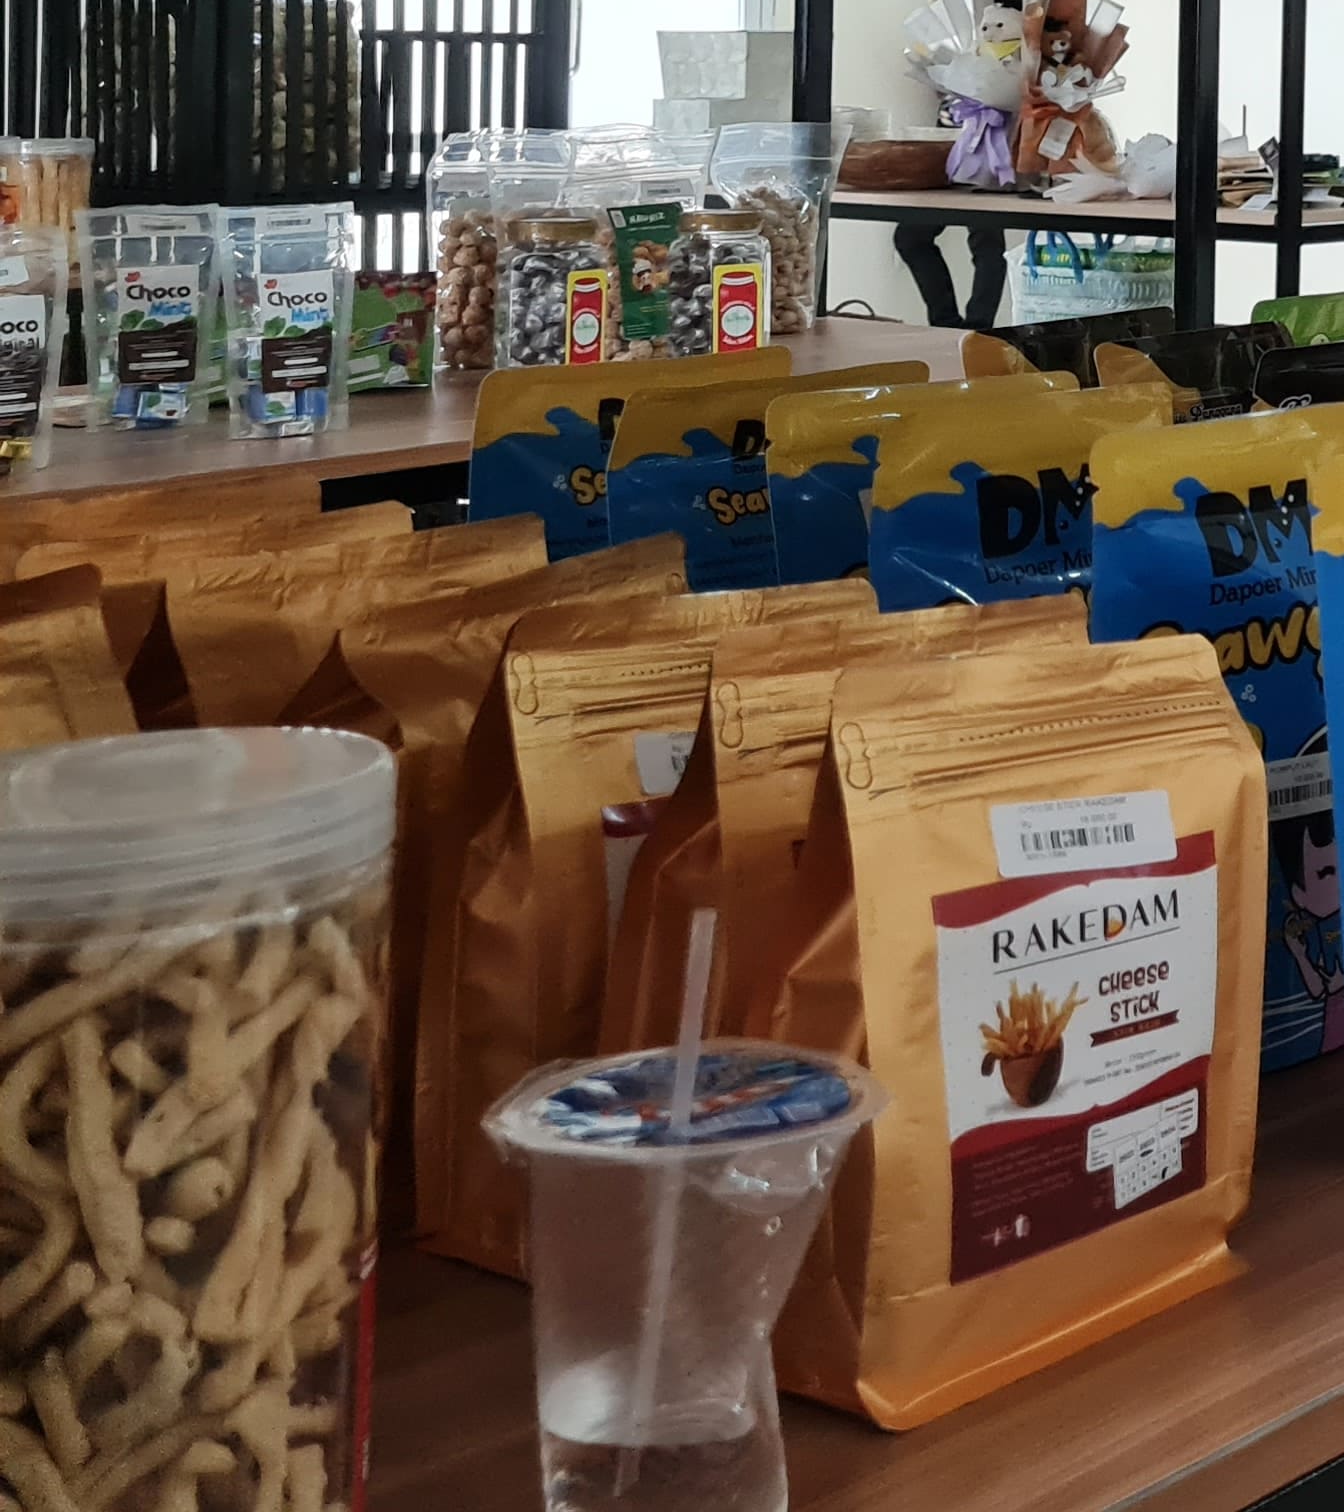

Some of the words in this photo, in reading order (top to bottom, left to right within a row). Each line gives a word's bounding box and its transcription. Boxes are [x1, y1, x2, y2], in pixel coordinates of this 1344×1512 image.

[126, 285, 191, 302] Choco
[267, 291, 328, 308] Choco
[0, 320, 39, 334] oco
[708, 486, 770, 526] Sea
[1195, 478, 1314, 578] DM
[984, 558, 1057, 585] Dapoer
[1209, 576, 1283, 607] Dapoer
[993, 889, 1180, 964] RAKEDAM
